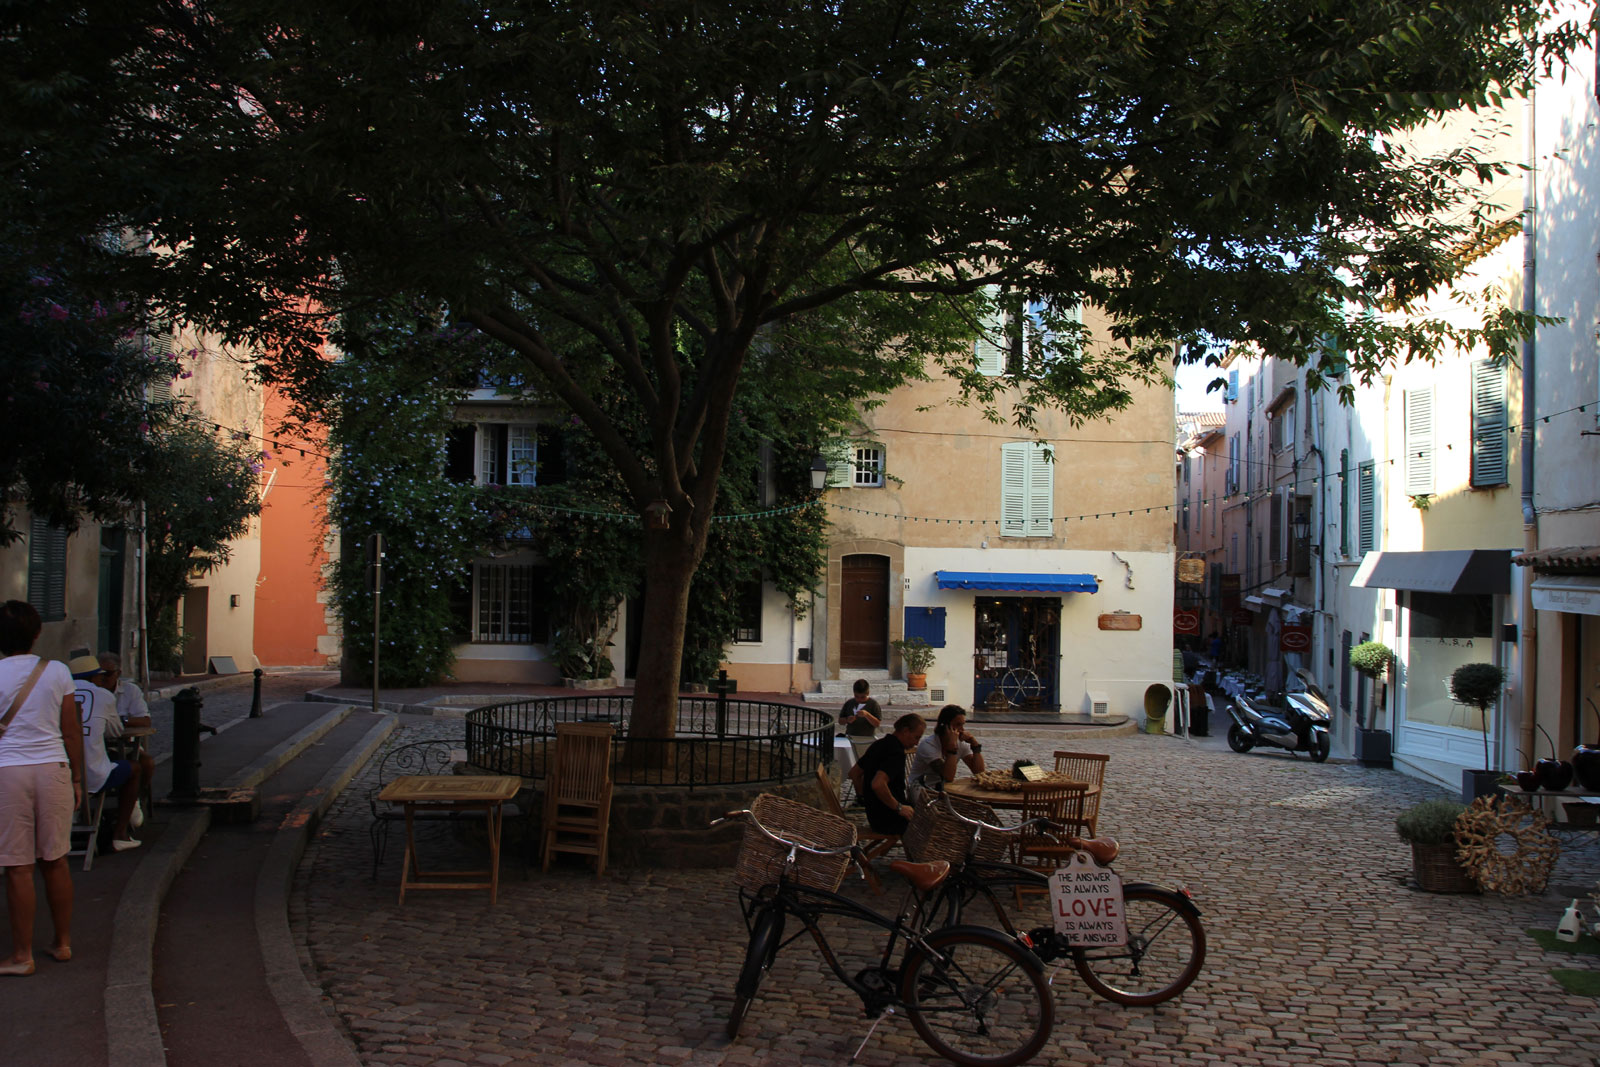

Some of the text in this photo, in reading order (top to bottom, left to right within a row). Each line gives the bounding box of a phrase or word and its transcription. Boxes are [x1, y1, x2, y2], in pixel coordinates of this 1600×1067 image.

[1058, 872, 1111, 882] THE ANSWER
[1061, 884, 1110, 894] IS ALWAYS
[1058, 898, 1117, 917] LOVE
[1065, 921, 1114, 930] IS ALWAYS
[1065, 933, 1118, 942] THE ANSWER
